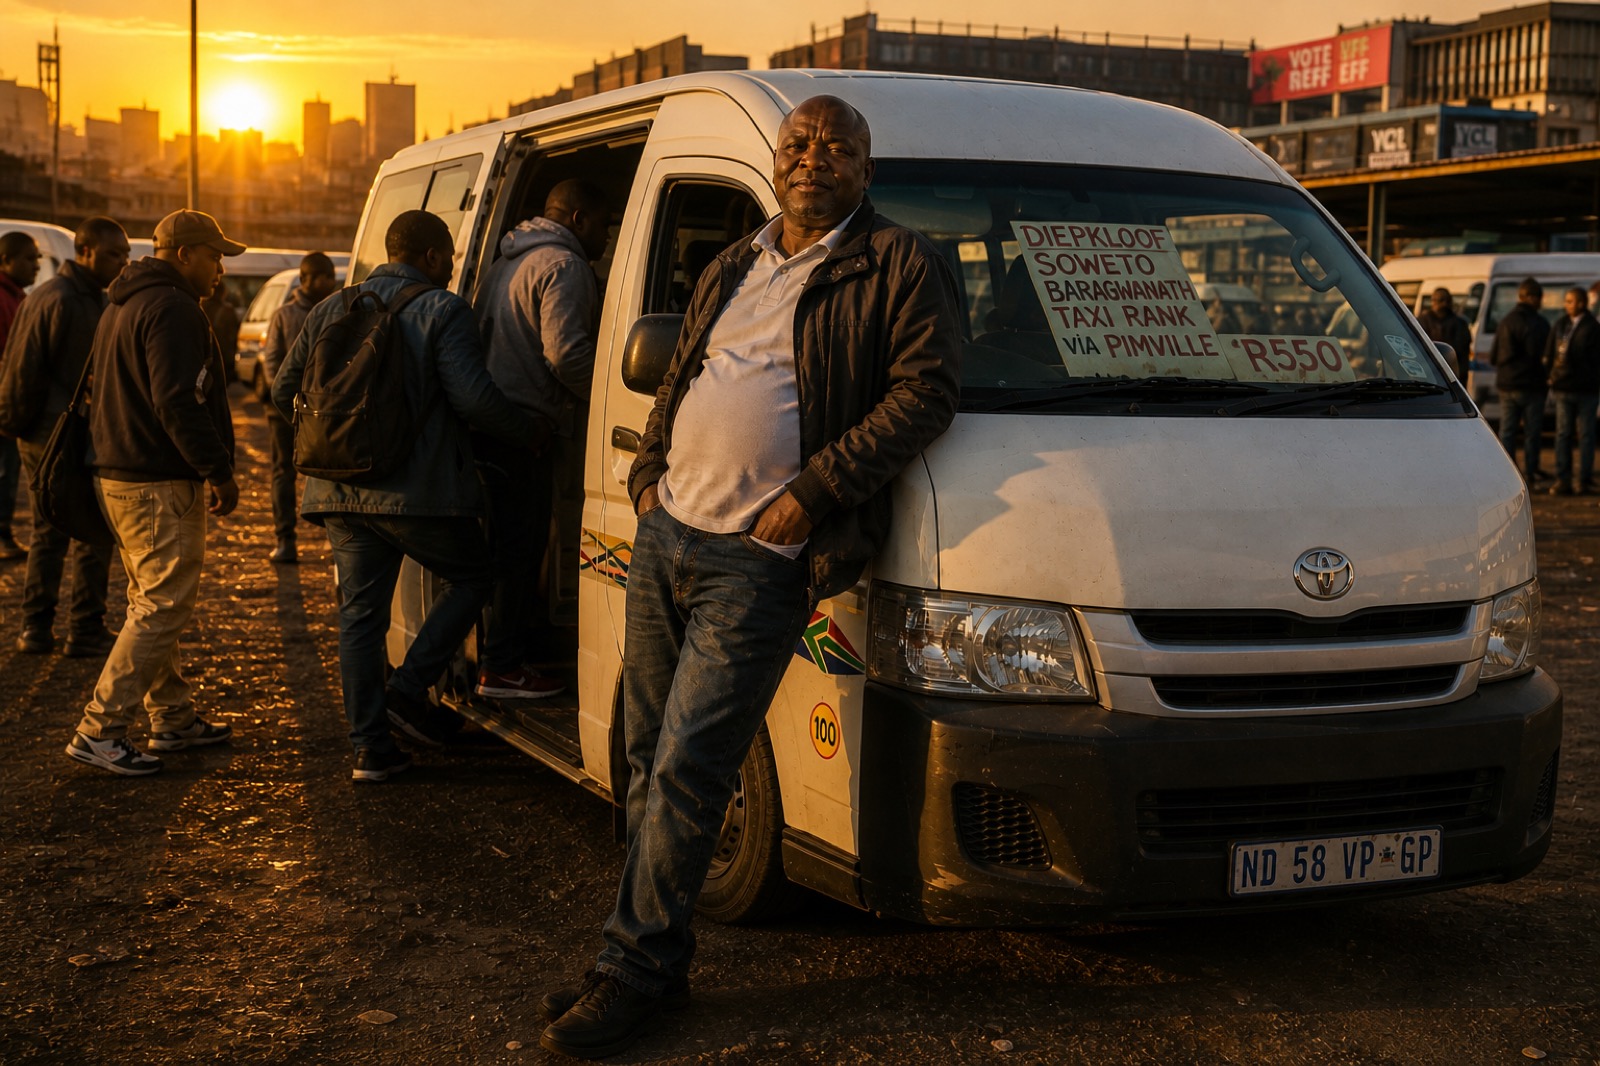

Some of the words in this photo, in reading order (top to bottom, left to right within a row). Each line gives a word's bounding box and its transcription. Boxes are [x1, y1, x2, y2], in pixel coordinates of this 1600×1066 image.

[1288, 43, 1332, 67] VOTE
[1289, 66, 1331, 92] REFF
[1340, 58, 1370, 84] EFF
[1019, 225, 1165, 249] DIEPKLOOF
[1034, 252, 1155, 276] SOWETO
[1044, 280, 1196, 302] BARAGWANATH
[1052, 305, 1115, 329] TAXI
[1122, 305, 1196, 328] RANK
[1103, 334, 1219, 358] PIMVILLE
[814, 715, 836, 747] 100
[1241, 848, 1277, 888] ND
[1292, 844, 1327, 885] 58
[1343, 840, 1375, 879] VP
[1401, 835, 1433, 874] GP
